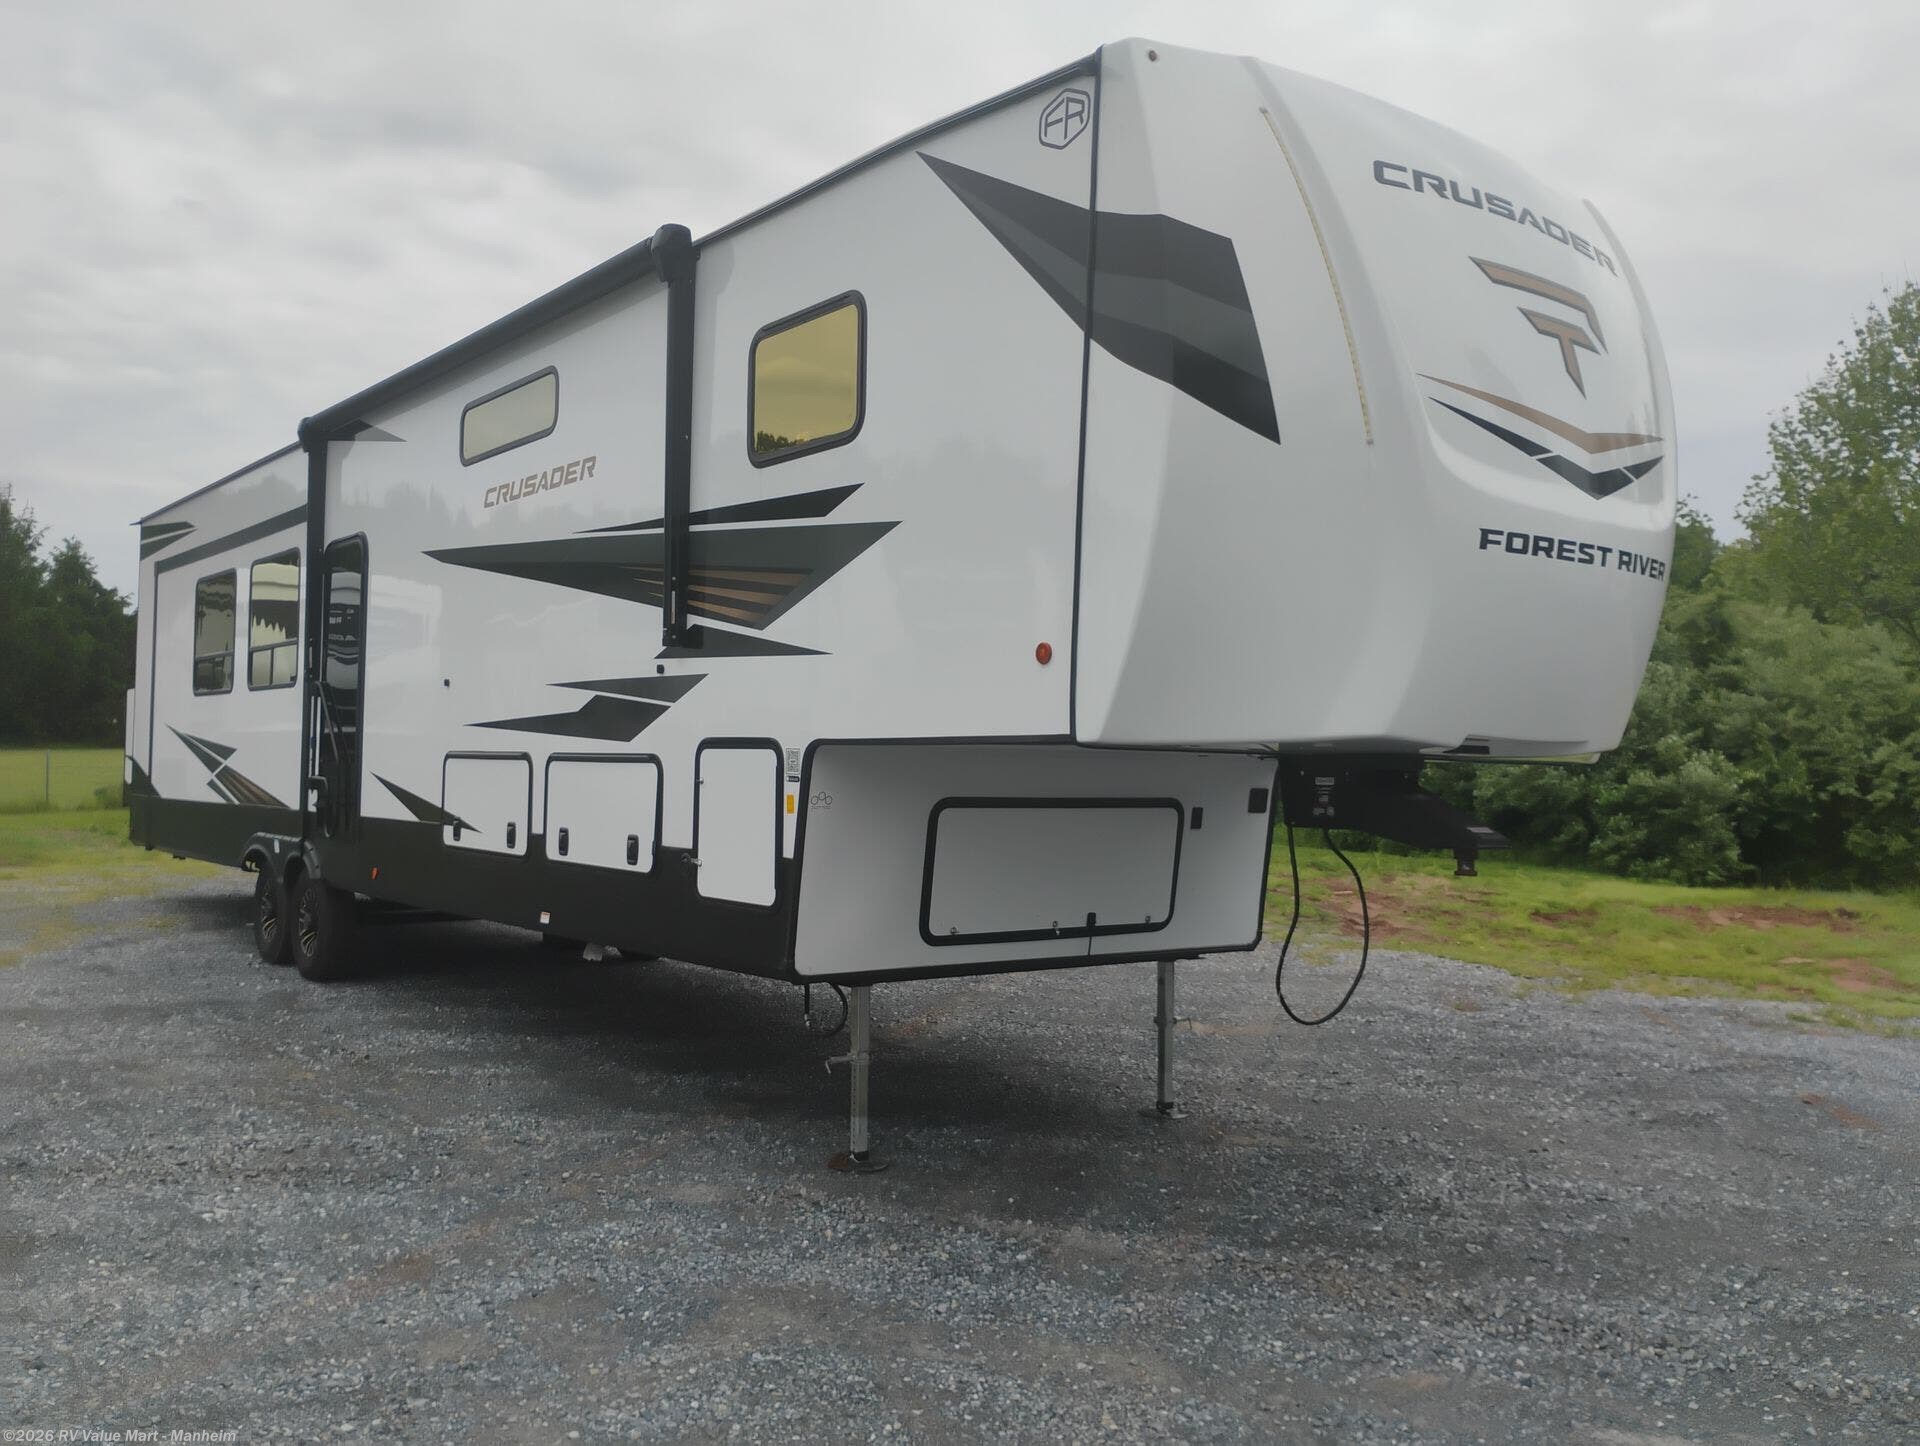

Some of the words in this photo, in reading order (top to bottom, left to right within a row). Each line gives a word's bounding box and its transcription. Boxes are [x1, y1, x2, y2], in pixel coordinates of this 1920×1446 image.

[1373, 159, 1618, 277] CRUSADER
[483, 455, 597, 509] CRUSADER
[1479, 528, 1613, 567] FOREST
[1617, 550, 1666, 581] RIVER
